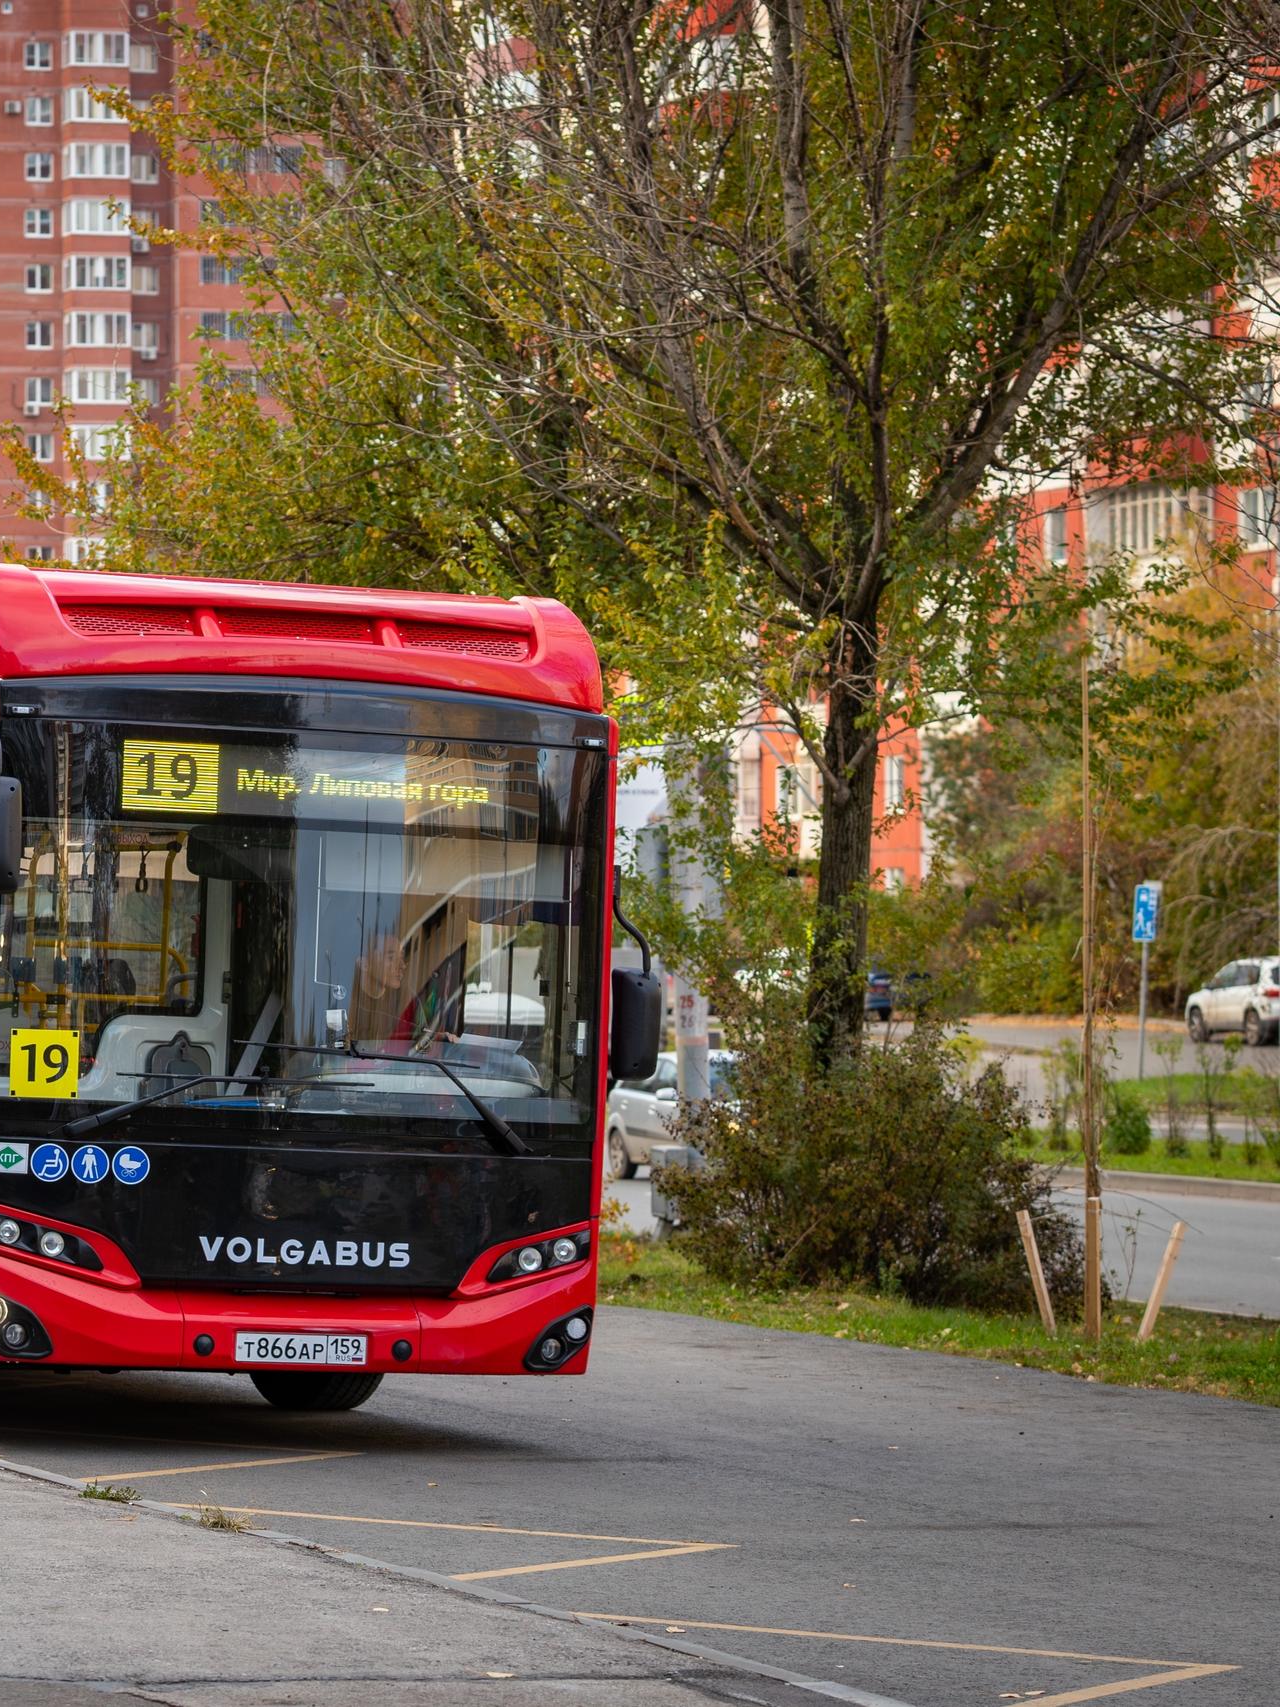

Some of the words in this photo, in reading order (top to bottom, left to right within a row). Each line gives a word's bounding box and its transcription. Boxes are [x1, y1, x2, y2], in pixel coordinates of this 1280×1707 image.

[137, 752, 197, 800] 19
[237, 767, 302, 800] Мкр.
[309, 773, 423, 799] Липовая
[429, 784, 489, 809] гора
[21, 1043, 69, 1084] 19
[199, 1236, 410, 1268] VOLGABUS
[330, 1338, 362, 1355] 159
[335, 1354, 352, 1362] RUS
